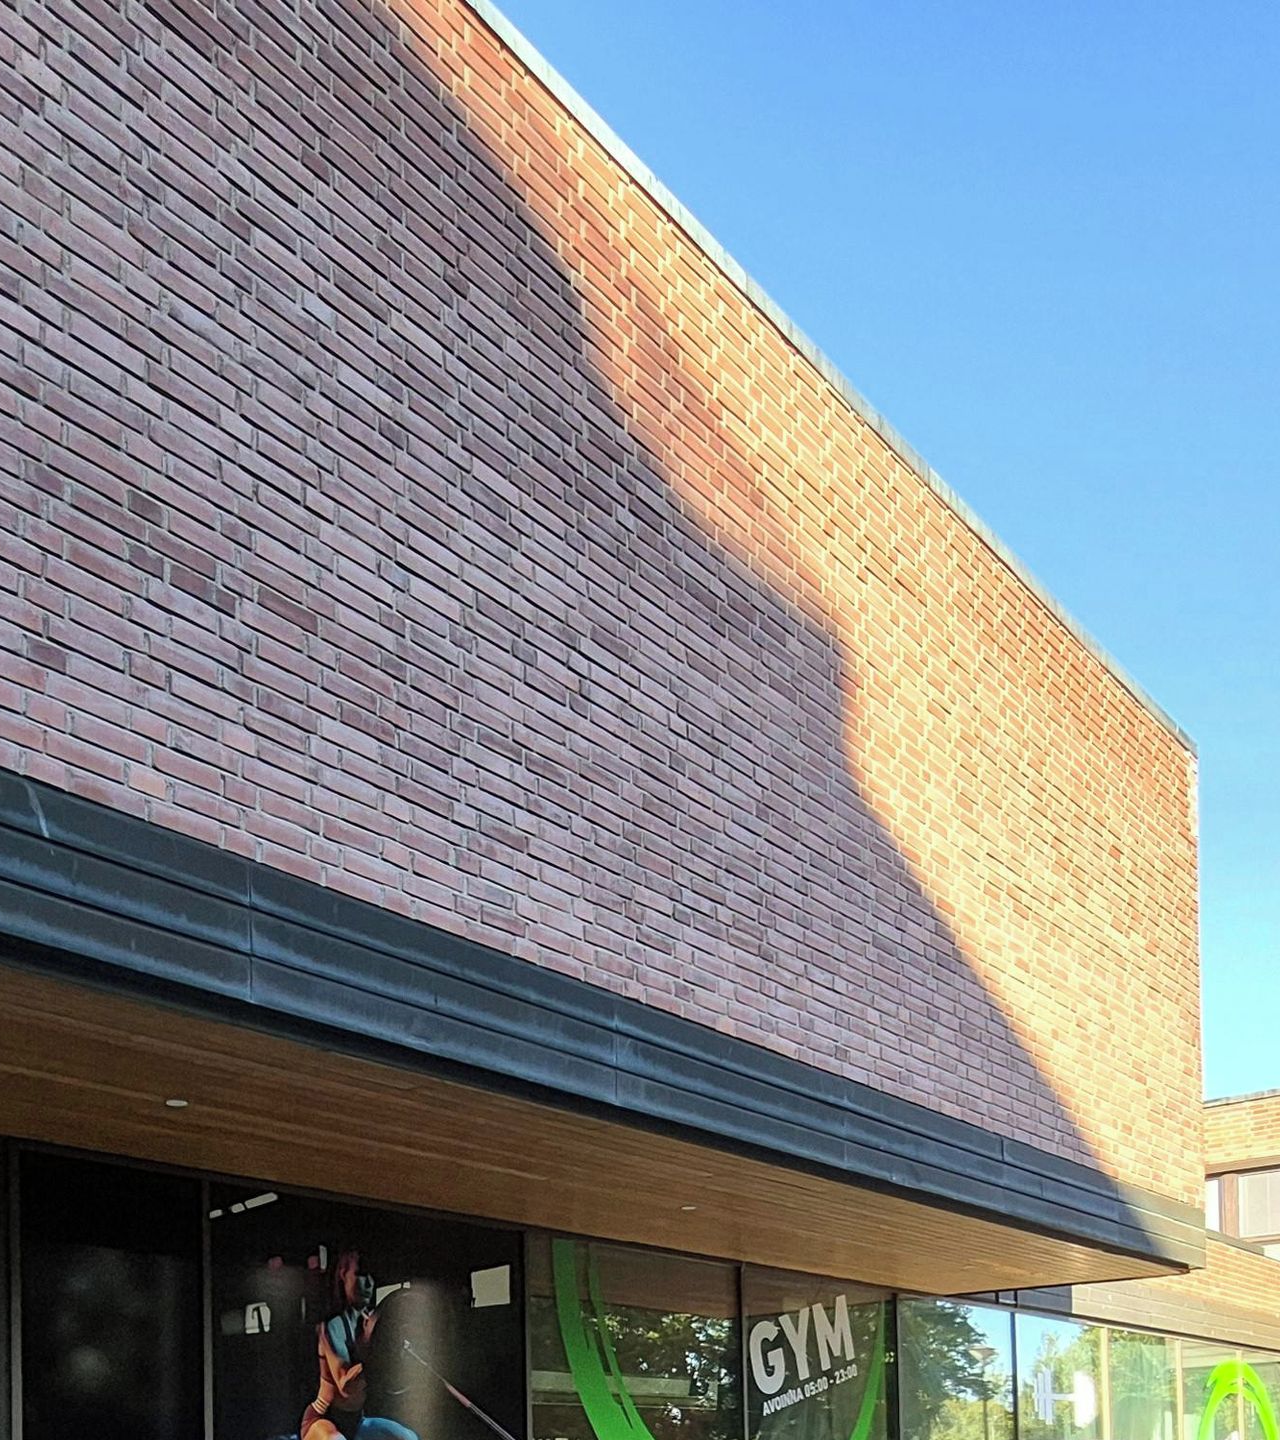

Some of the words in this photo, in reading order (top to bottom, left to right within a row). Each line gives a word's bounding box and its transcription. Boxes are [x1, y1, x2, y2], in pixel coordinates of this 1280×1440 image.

[749, 1294, 855, 1394] GYM
[762, 1387, 804, 1416] AVOINNA
[803, 1376, 829, 1398] 05:00
[834, 1363, 858, 1385] 23:00
